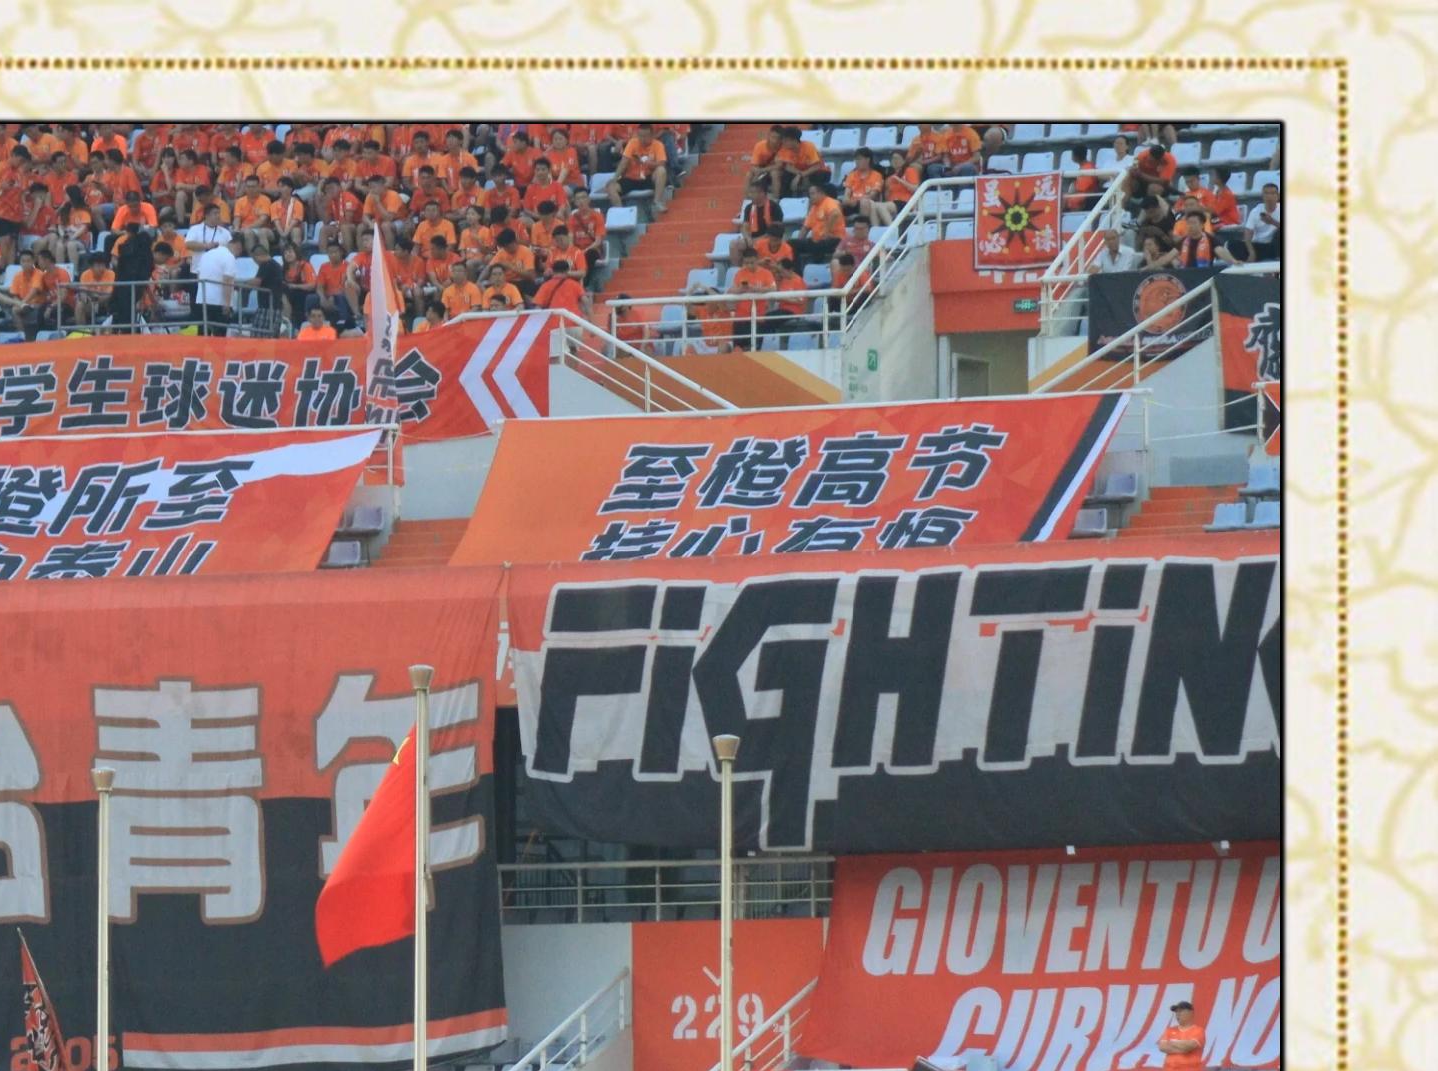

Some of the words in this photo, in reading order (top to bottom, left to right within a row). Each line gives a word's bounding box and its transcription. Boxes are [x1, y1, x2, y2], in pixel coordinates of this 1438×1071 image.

[595, 421, 1009, 517] 至橙高节
[524, 556, 1280, 851] FIGHTIN
